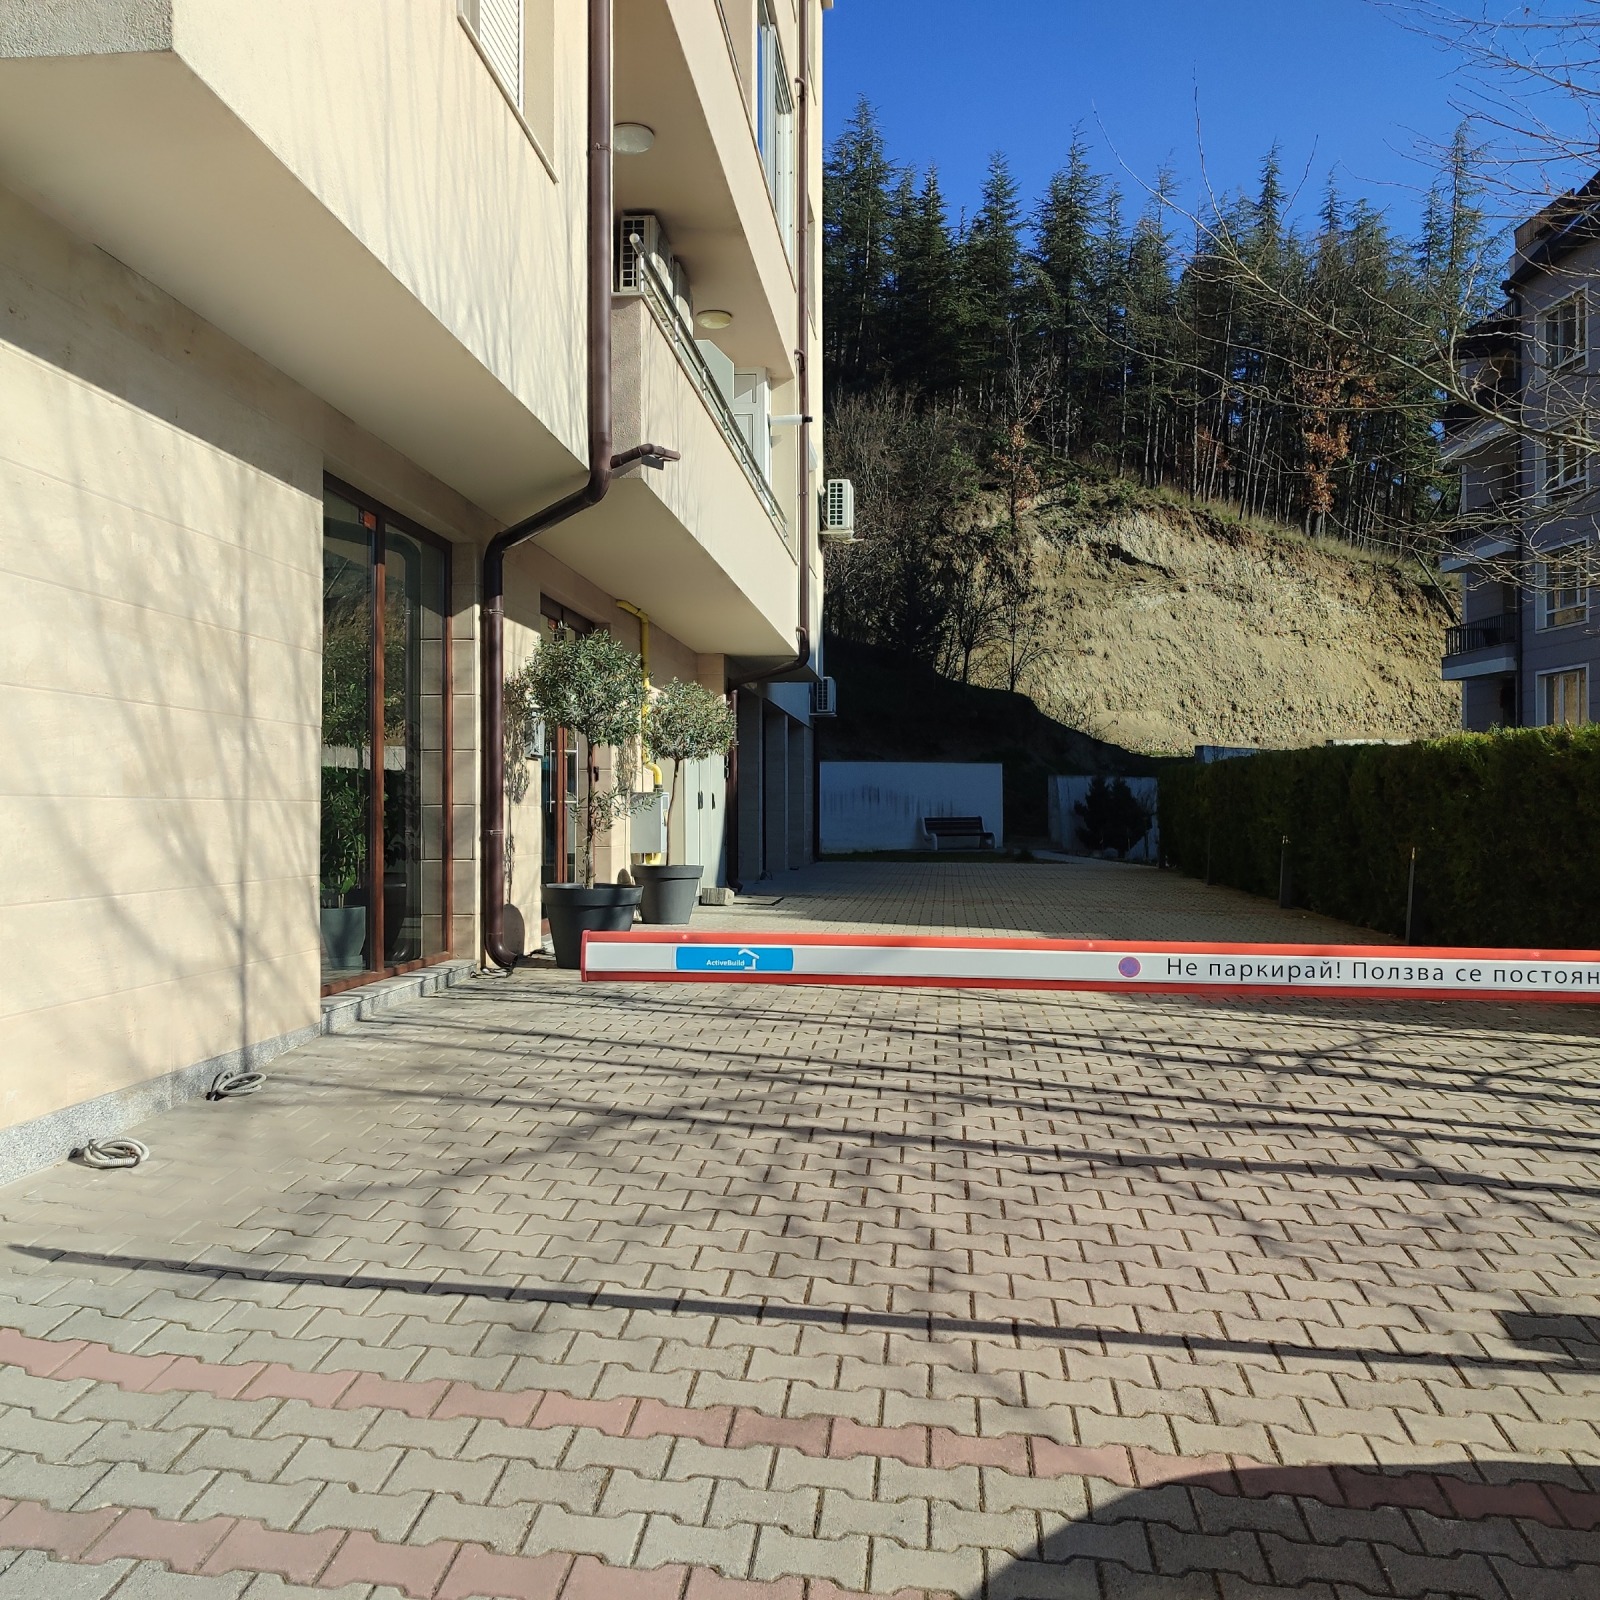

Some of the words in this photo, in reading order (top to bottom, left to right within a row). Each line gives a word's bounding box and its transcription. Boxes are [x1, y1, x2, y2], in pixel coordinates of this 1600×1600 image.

[1167, 957, 1198, 976] Не
[1208, 961, 1342, 983] паркирай!
[1352, 961, 1444, 982] Ползва
[1455, 968, 1482, 982] се
[1493, 969, 1600, 985] постоян
